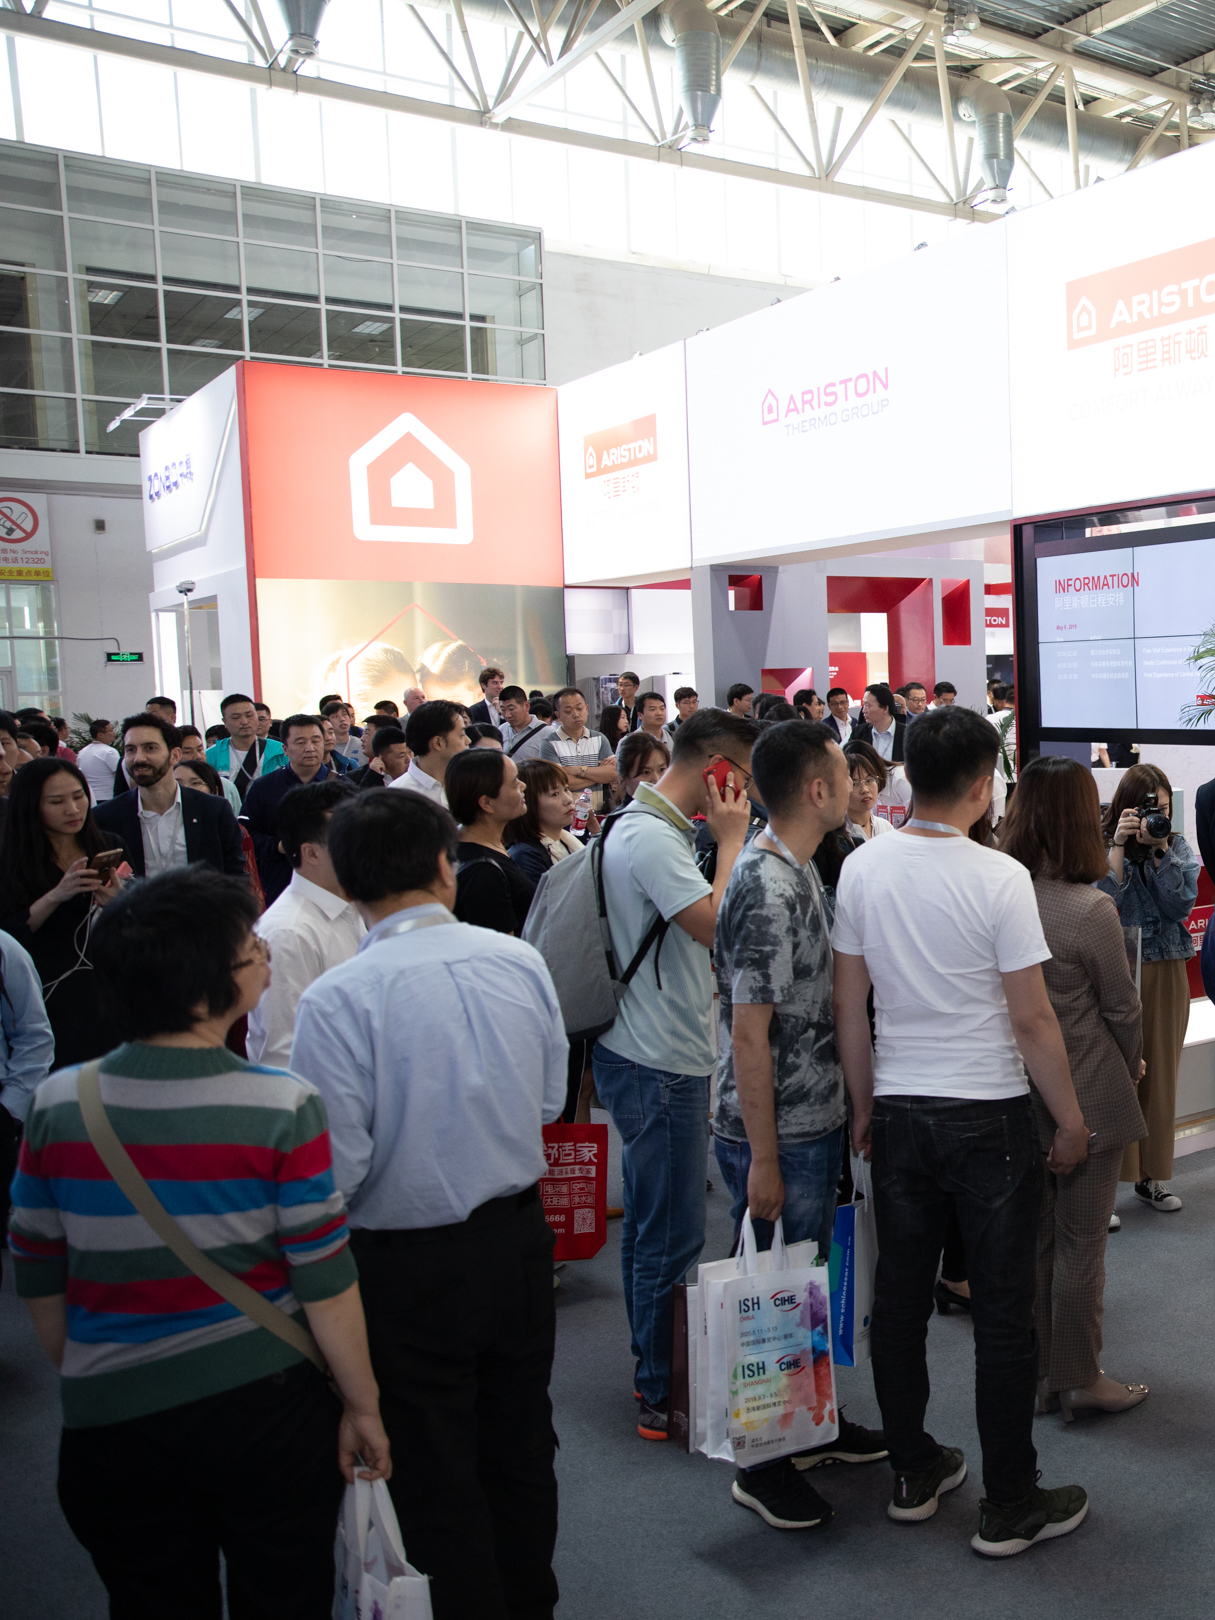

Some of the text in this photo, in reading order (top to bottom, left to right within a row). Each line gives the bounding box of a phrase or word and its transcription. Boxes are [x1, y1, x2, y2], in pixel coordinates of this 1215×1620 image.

[1113, 324, 1208, 379] 阿里斯顿
[784, 366, 889, 418] ARISTON
[784, 397, 890, 437] THERMO GROUP
[601, 436, 654, 469] ARISTON
[0, 556, 46, 565] 电话12320
[1054, 571, 1140, 594] INFORMATION
[738, 1296, 761, 1314] ISH
[773, 1294, 797, 1308] CIHE
[742, 1360, 766, 1380] ISH
[779, 1358, 802, 1372] CIHE
[743, 1377, 772, 1388] SHANGHAI
